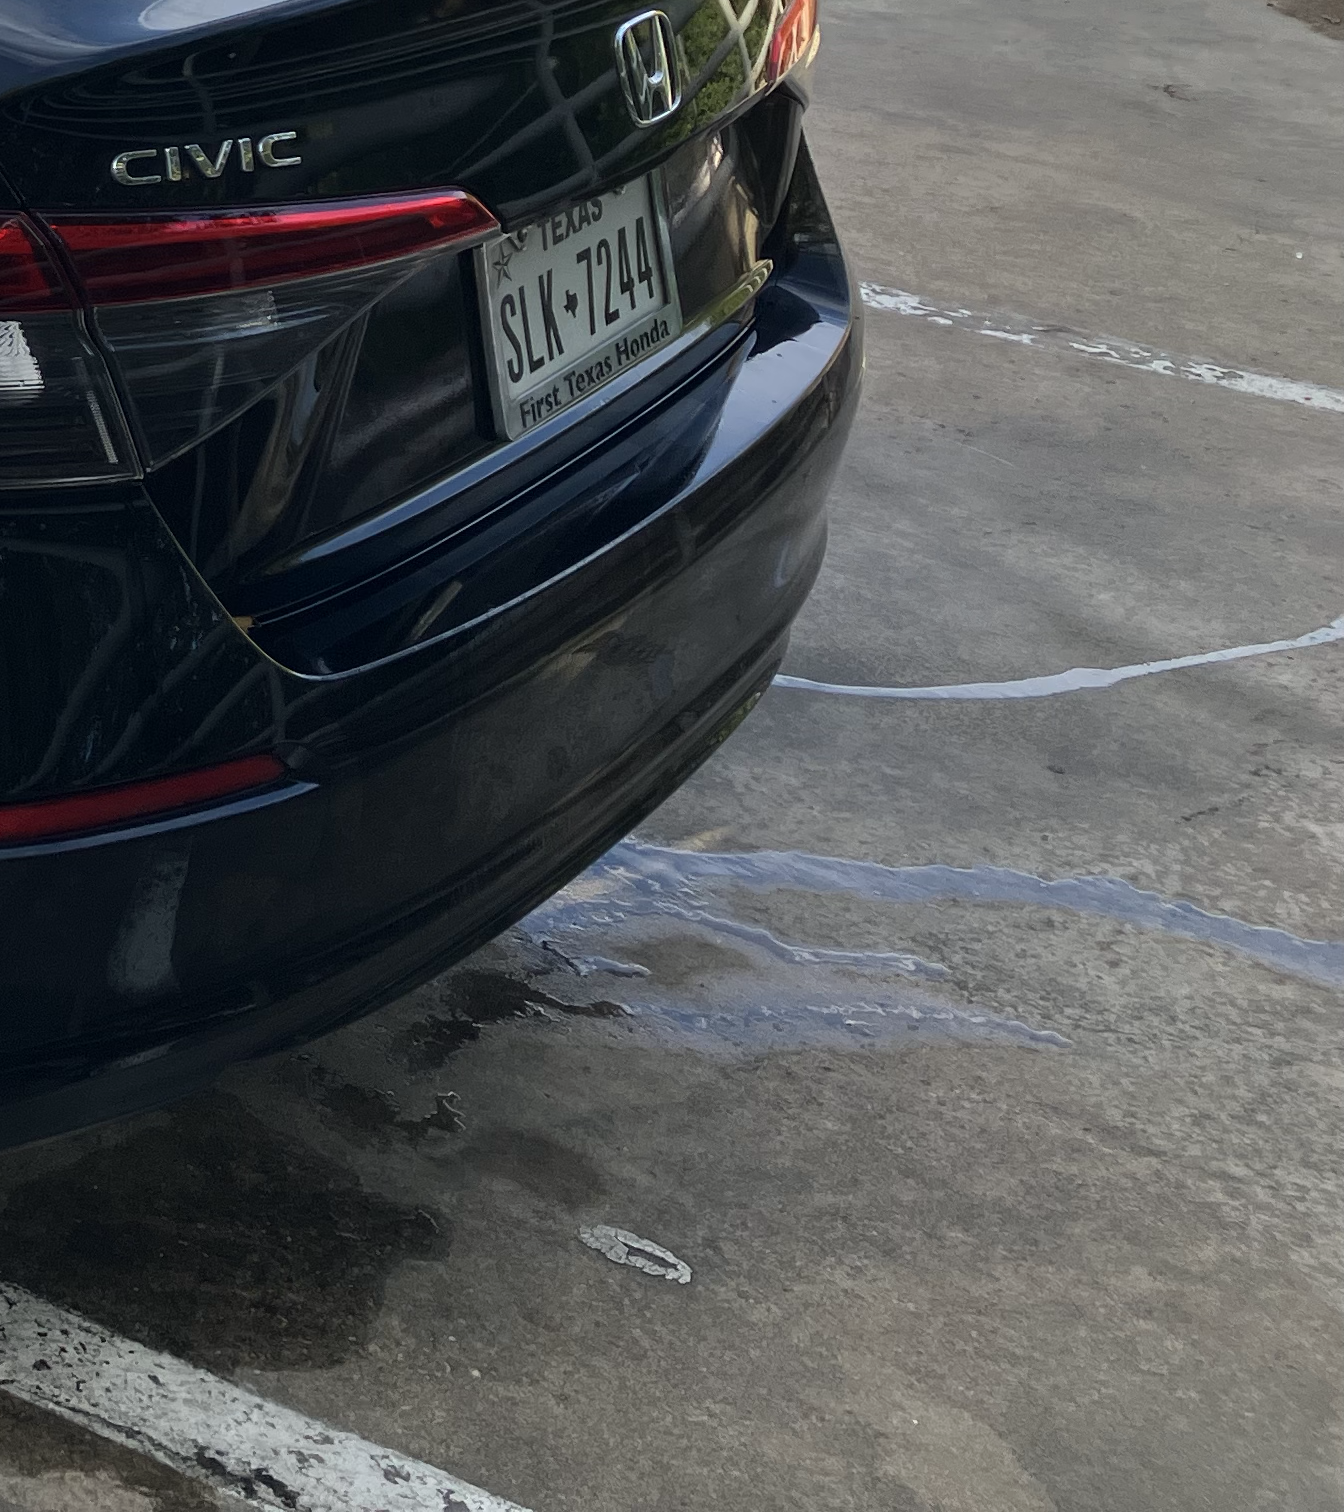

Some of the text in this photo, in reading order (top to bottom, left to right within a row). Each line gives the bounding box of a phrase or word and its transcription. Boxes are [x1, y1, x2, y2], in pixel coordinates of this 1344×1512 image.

[111, 130, 303, 186] CIVIC
[536, 197, 603, 252] TEXAS
[518, 317, 671, 429] First Texas Honda
